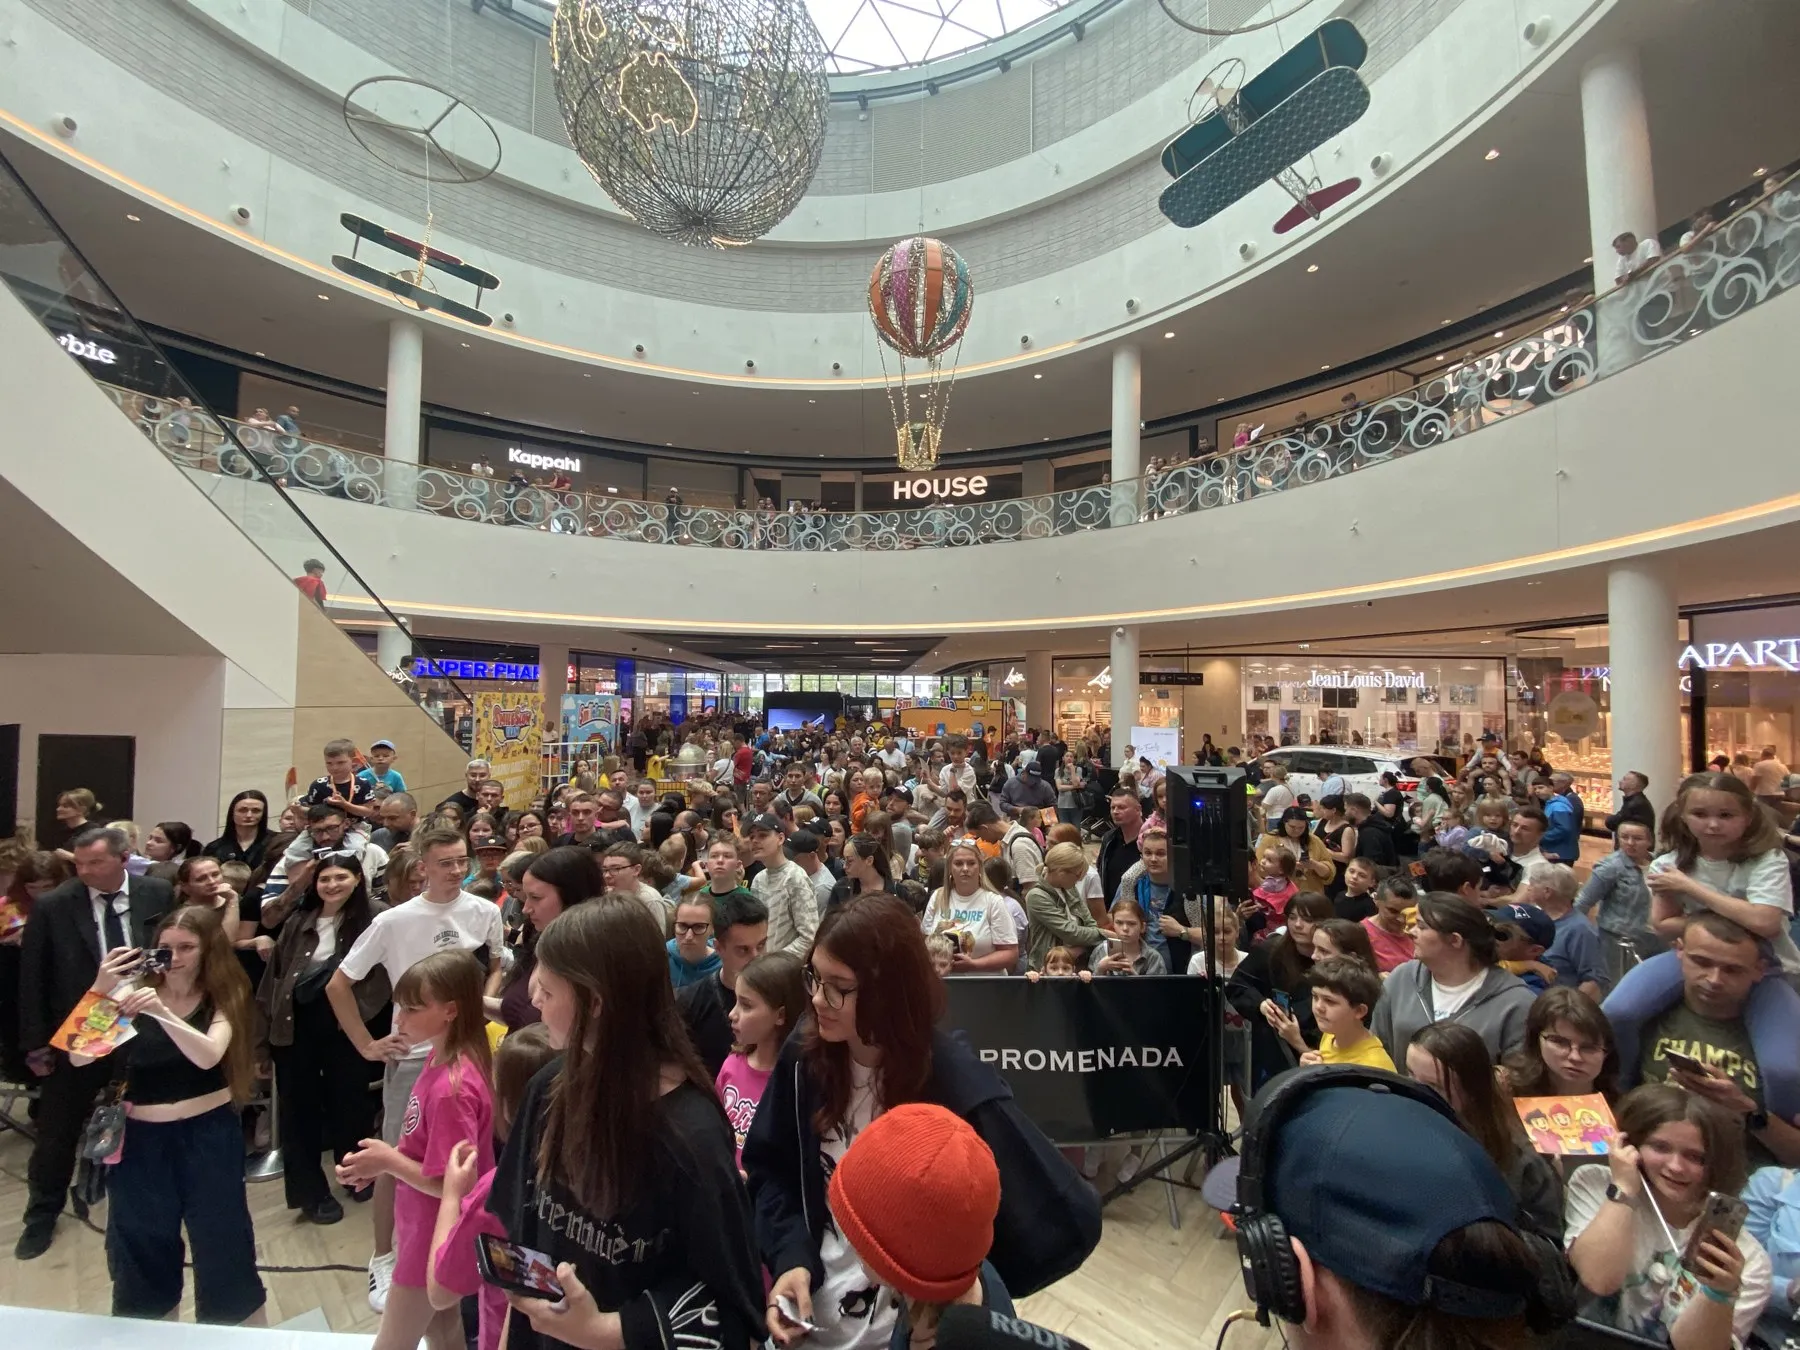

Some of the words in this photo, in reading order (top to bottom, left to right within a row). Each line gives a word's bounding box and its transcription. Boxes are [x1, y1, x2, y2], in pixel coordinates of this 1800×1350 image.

[508, 448, 581, 472] Kappahl
[1678, 640, 1800, 671] APART
[1307, 670, 1341, 687] Jean
[1343, 671, 1382, 688] Louis
[1385, 671, 1425, 688] David
[979, 1046, 1184, 1073] PROMENADA
[1653, 1037, 1757, 1089] CHAMPS
